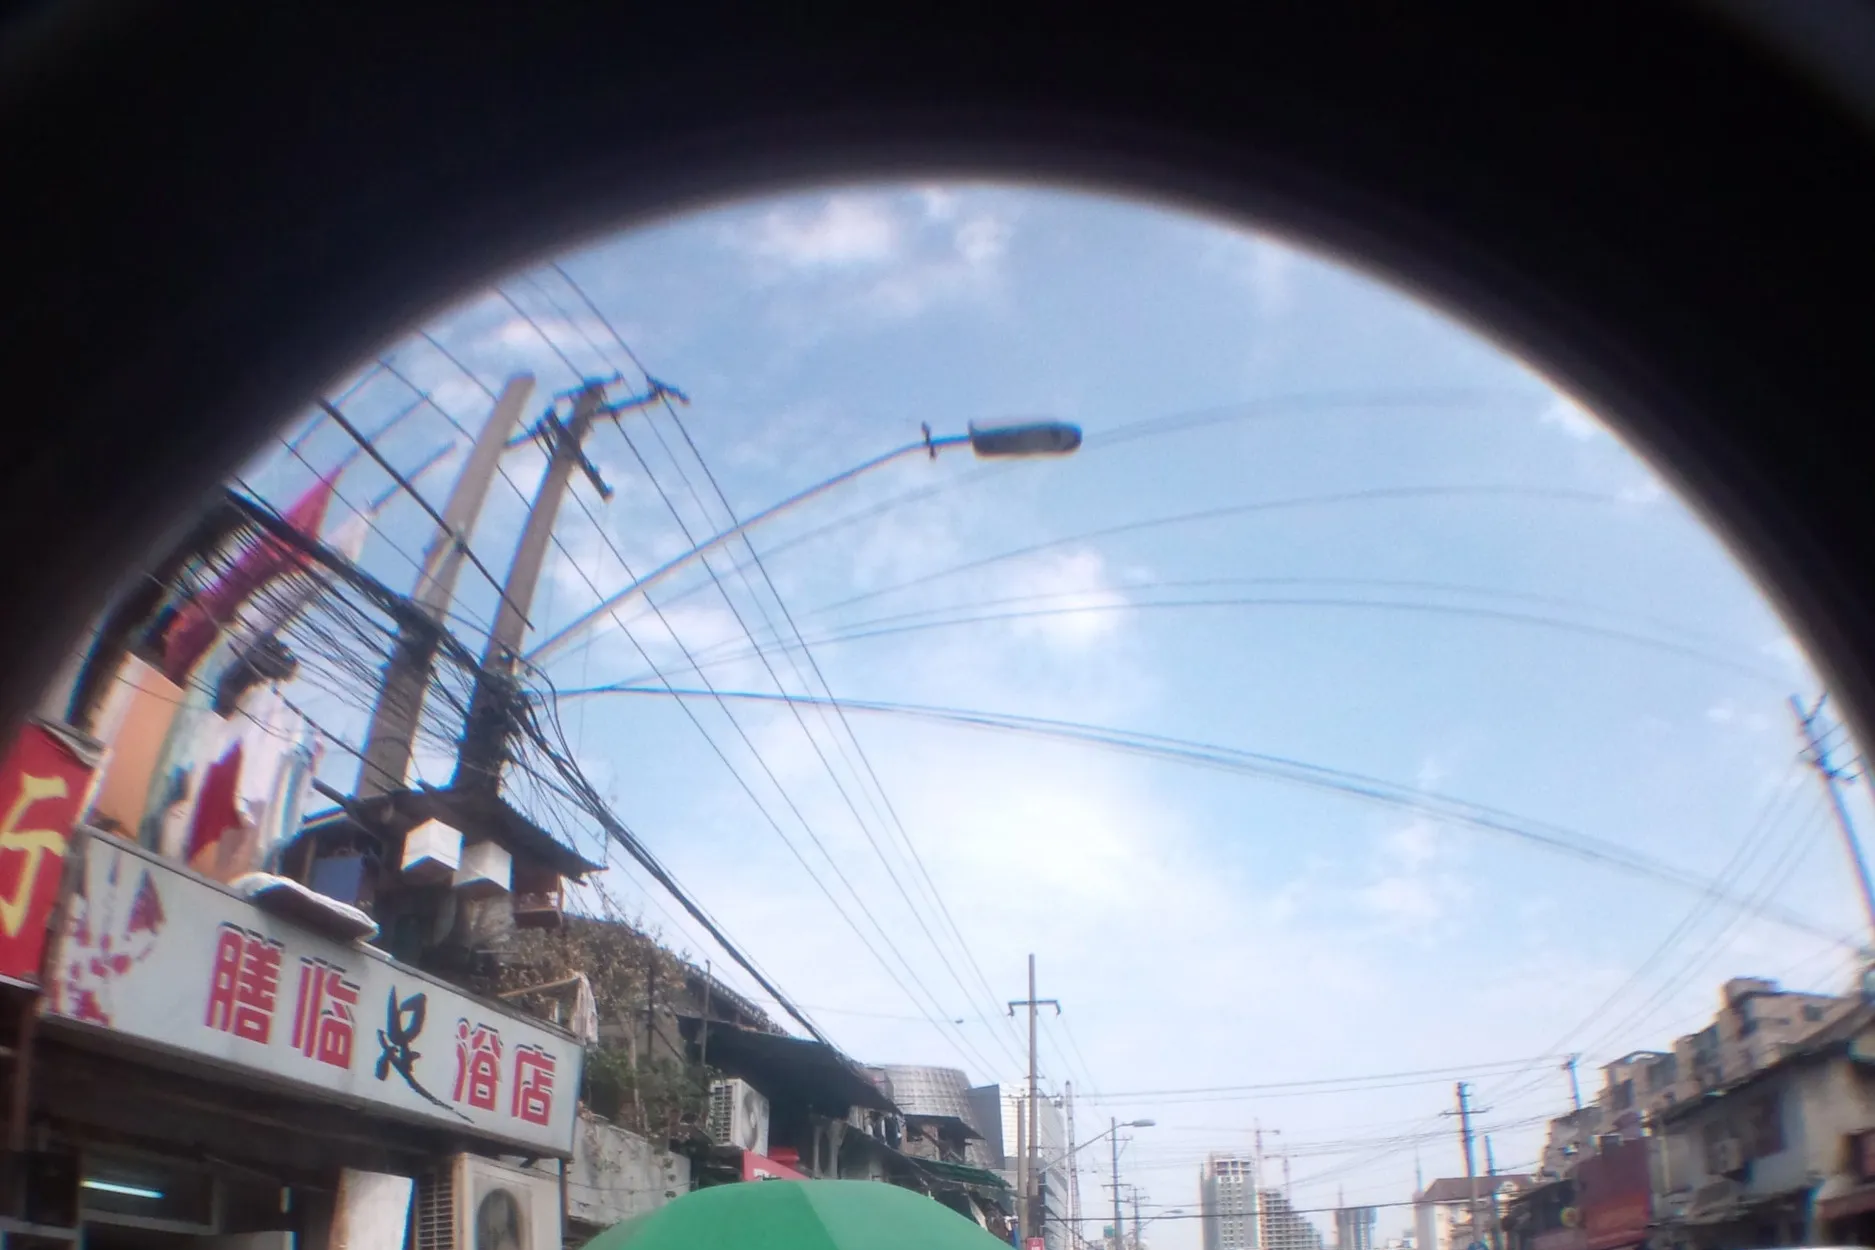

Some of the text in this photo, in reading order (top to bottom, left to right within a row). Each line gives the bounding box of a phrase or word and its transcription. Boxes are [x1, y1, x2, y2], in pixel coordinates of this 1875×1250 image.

[204, 920, 557, 1127] 膳临足浴店
